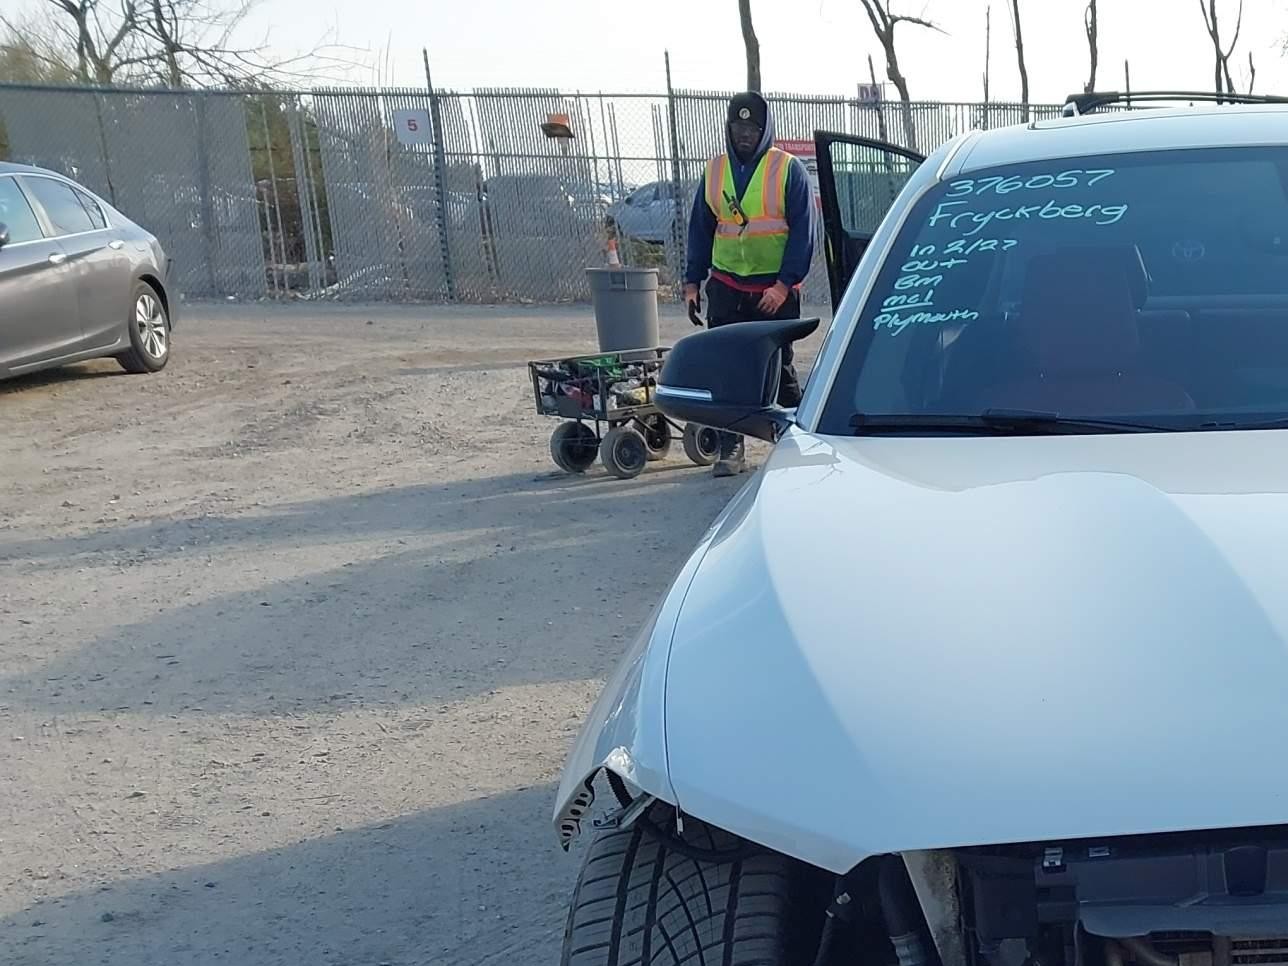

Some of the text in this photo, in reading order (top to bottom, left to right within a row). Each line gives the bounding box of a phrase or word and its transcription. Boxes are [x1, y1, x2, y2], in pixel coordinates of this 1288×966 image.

[407, 119, 418, 132] 5
[945, 169, 1115, 197] 376057
[929, 200, 1128, 235] Fryckberg
